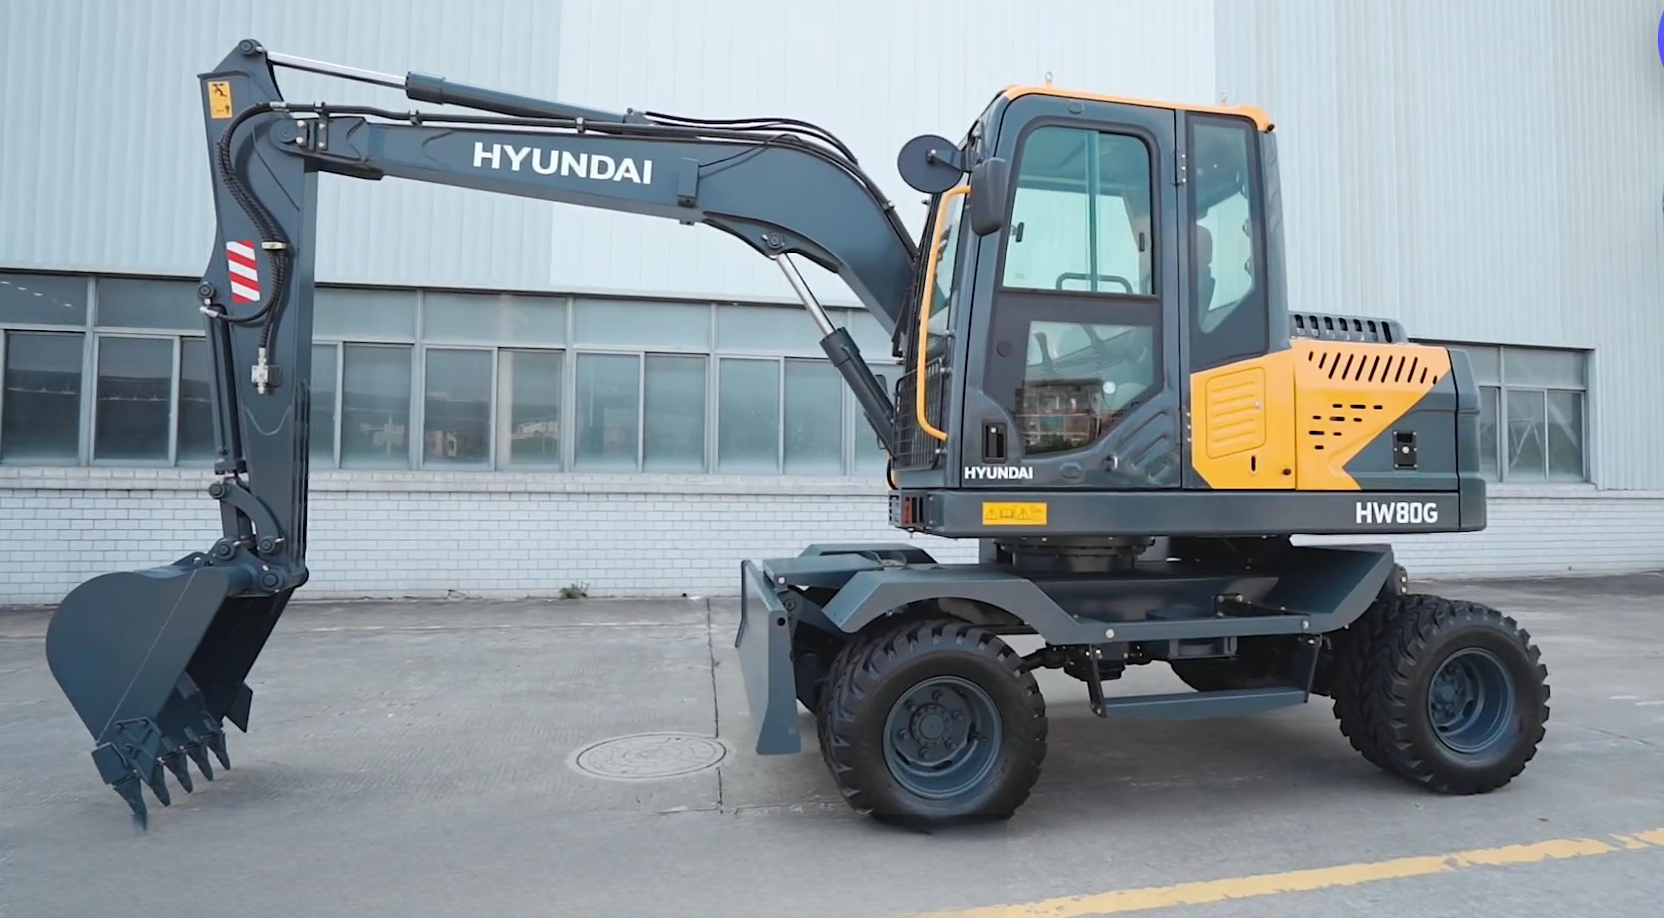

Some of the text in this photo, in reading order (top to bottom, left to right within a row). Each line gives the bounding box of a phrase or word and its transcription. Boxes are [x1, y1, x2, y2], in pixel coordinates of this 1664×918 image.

[473, 142, 652, 185] HYUNDAI
[964, 466, 1033, 479] HYUNDAI
[1356, 502, 1438, 524] HW80G
